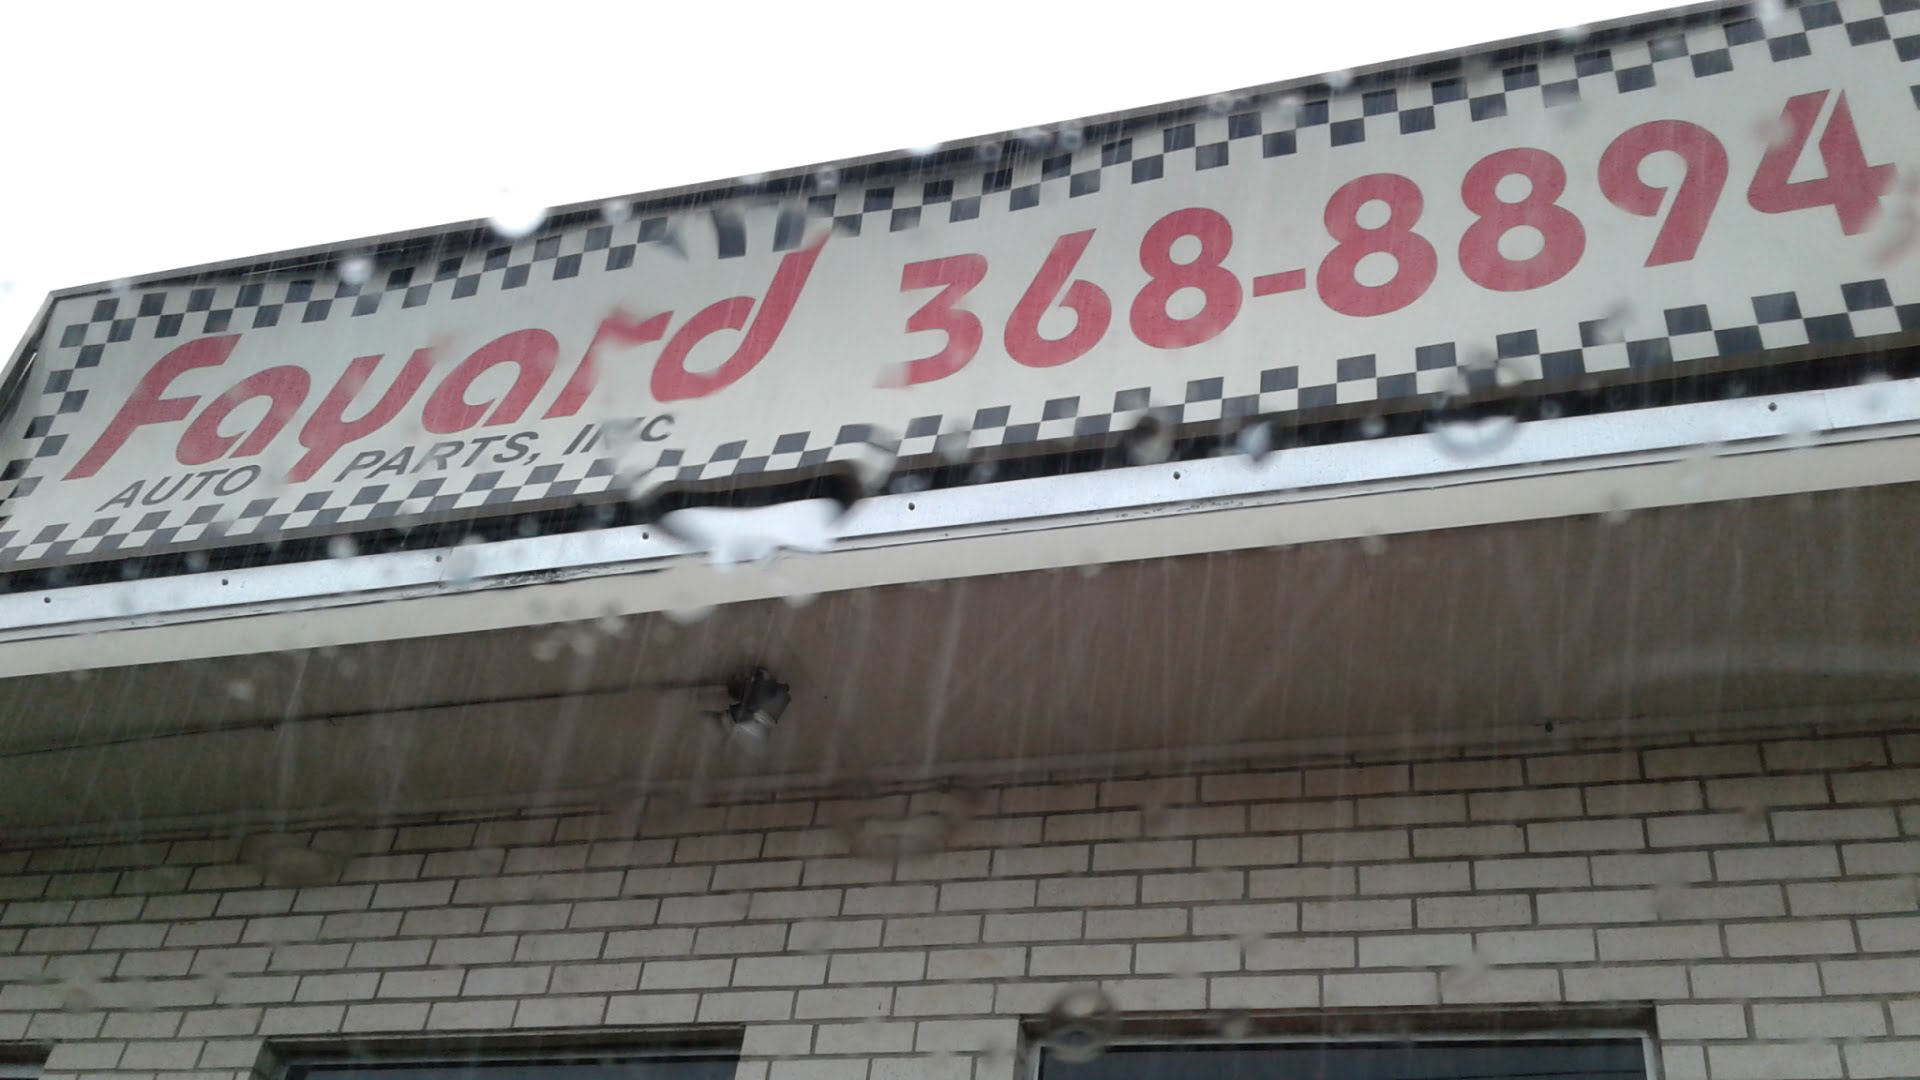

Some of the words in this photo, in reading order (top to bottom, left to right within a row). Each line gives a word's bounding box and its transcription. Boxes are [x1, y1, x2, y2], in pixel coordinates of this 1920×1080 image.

[61, 232, 831, 483] Fayard
[873, 88, 1897, 389] 368-8894
[94, 464, 262, 513] AUTO
[332, 431, 541, 483] PARTS,
